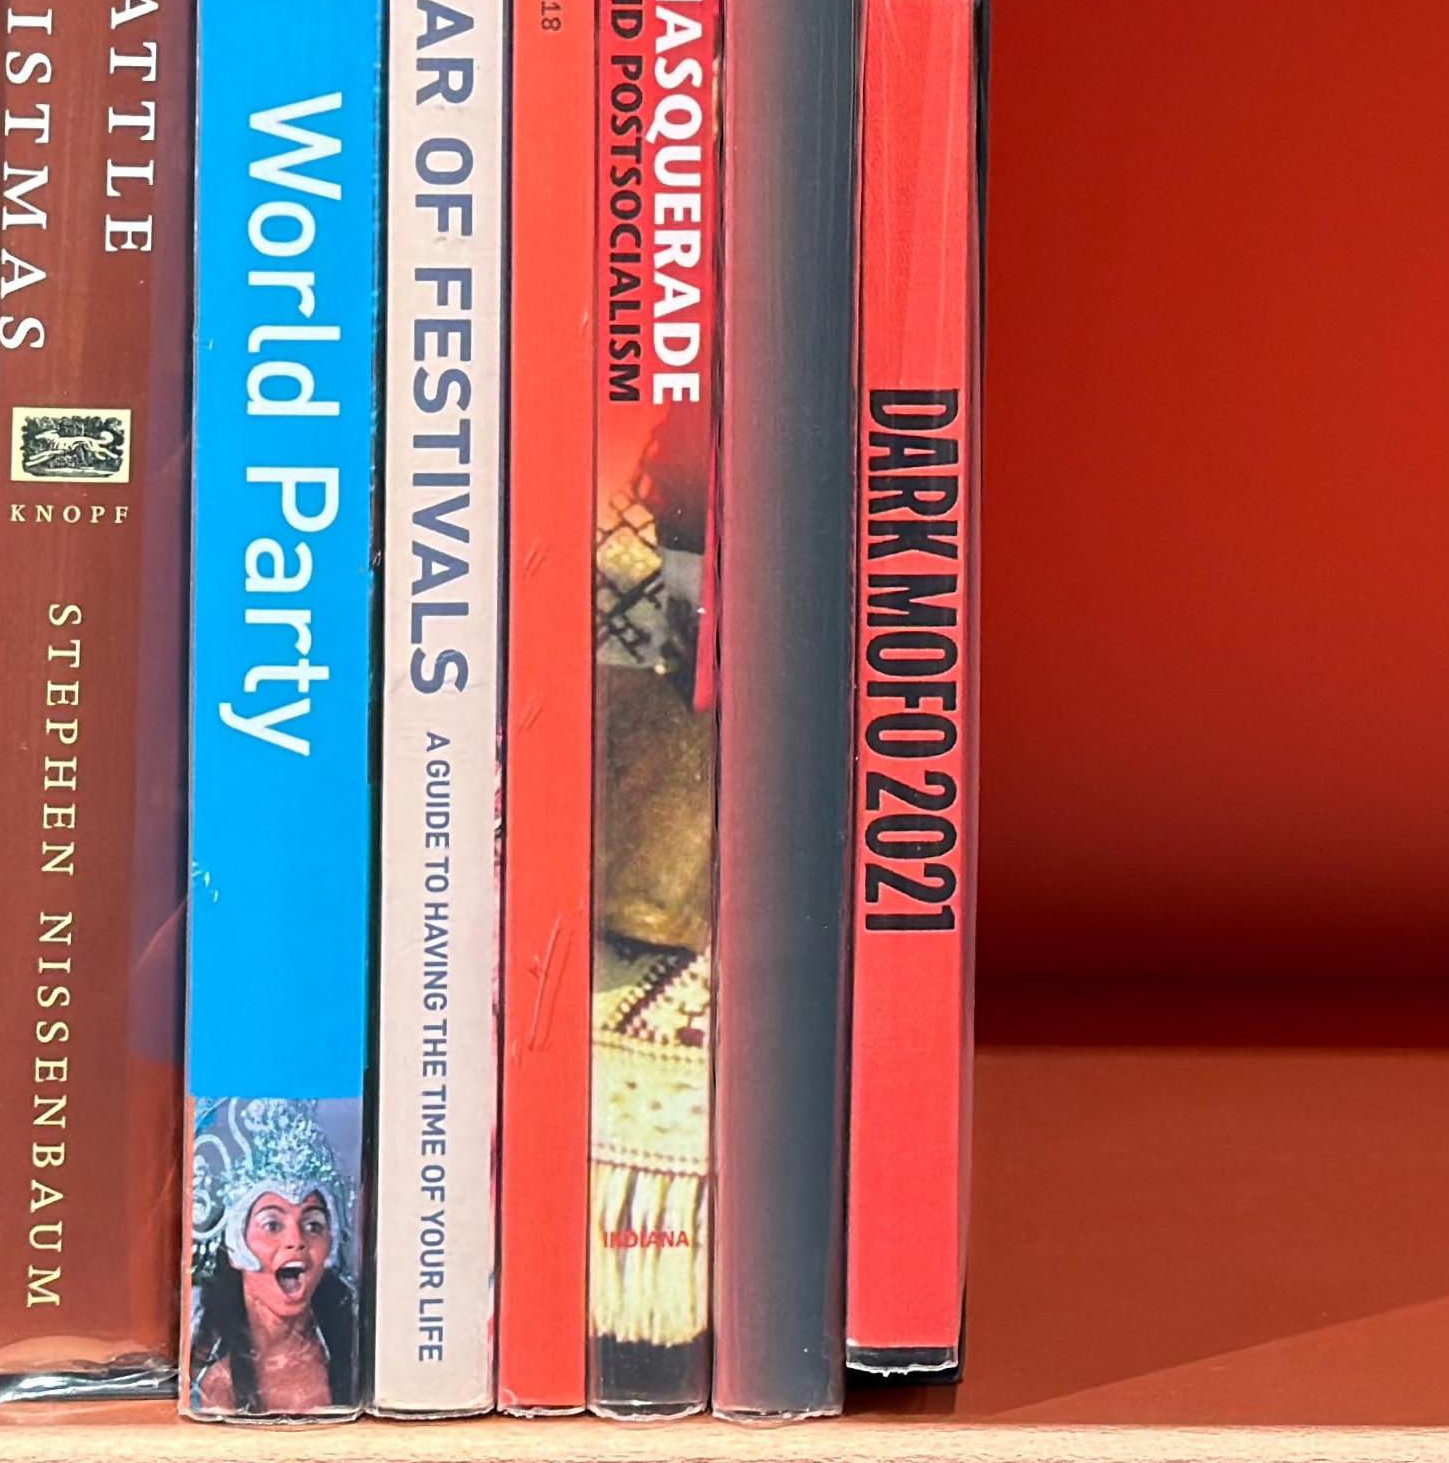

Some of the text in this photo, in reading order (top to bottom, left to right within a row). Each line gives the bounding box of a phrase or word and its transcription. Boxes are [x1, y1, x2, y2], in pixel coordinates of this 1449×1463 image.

[413, 137, 474, 237] OF
[608, 55, 642, 402] POSTSOCIALISM
[10, 504, 130, 524] KNOPF
[219, 92, 343, 757] World Party
[408, 267, 474, 696] FESTIVALS
[863, 389, 960, 933] DARK MOFO 2021
[26, 603, 83, 1309] STEPHEN NISSENBAUM
[417, 732, 451, 1363] A GUIDE TO HAVING THE TIME OF YOUR LIFE
[603, 1230, 690, 1248] INDIANA
